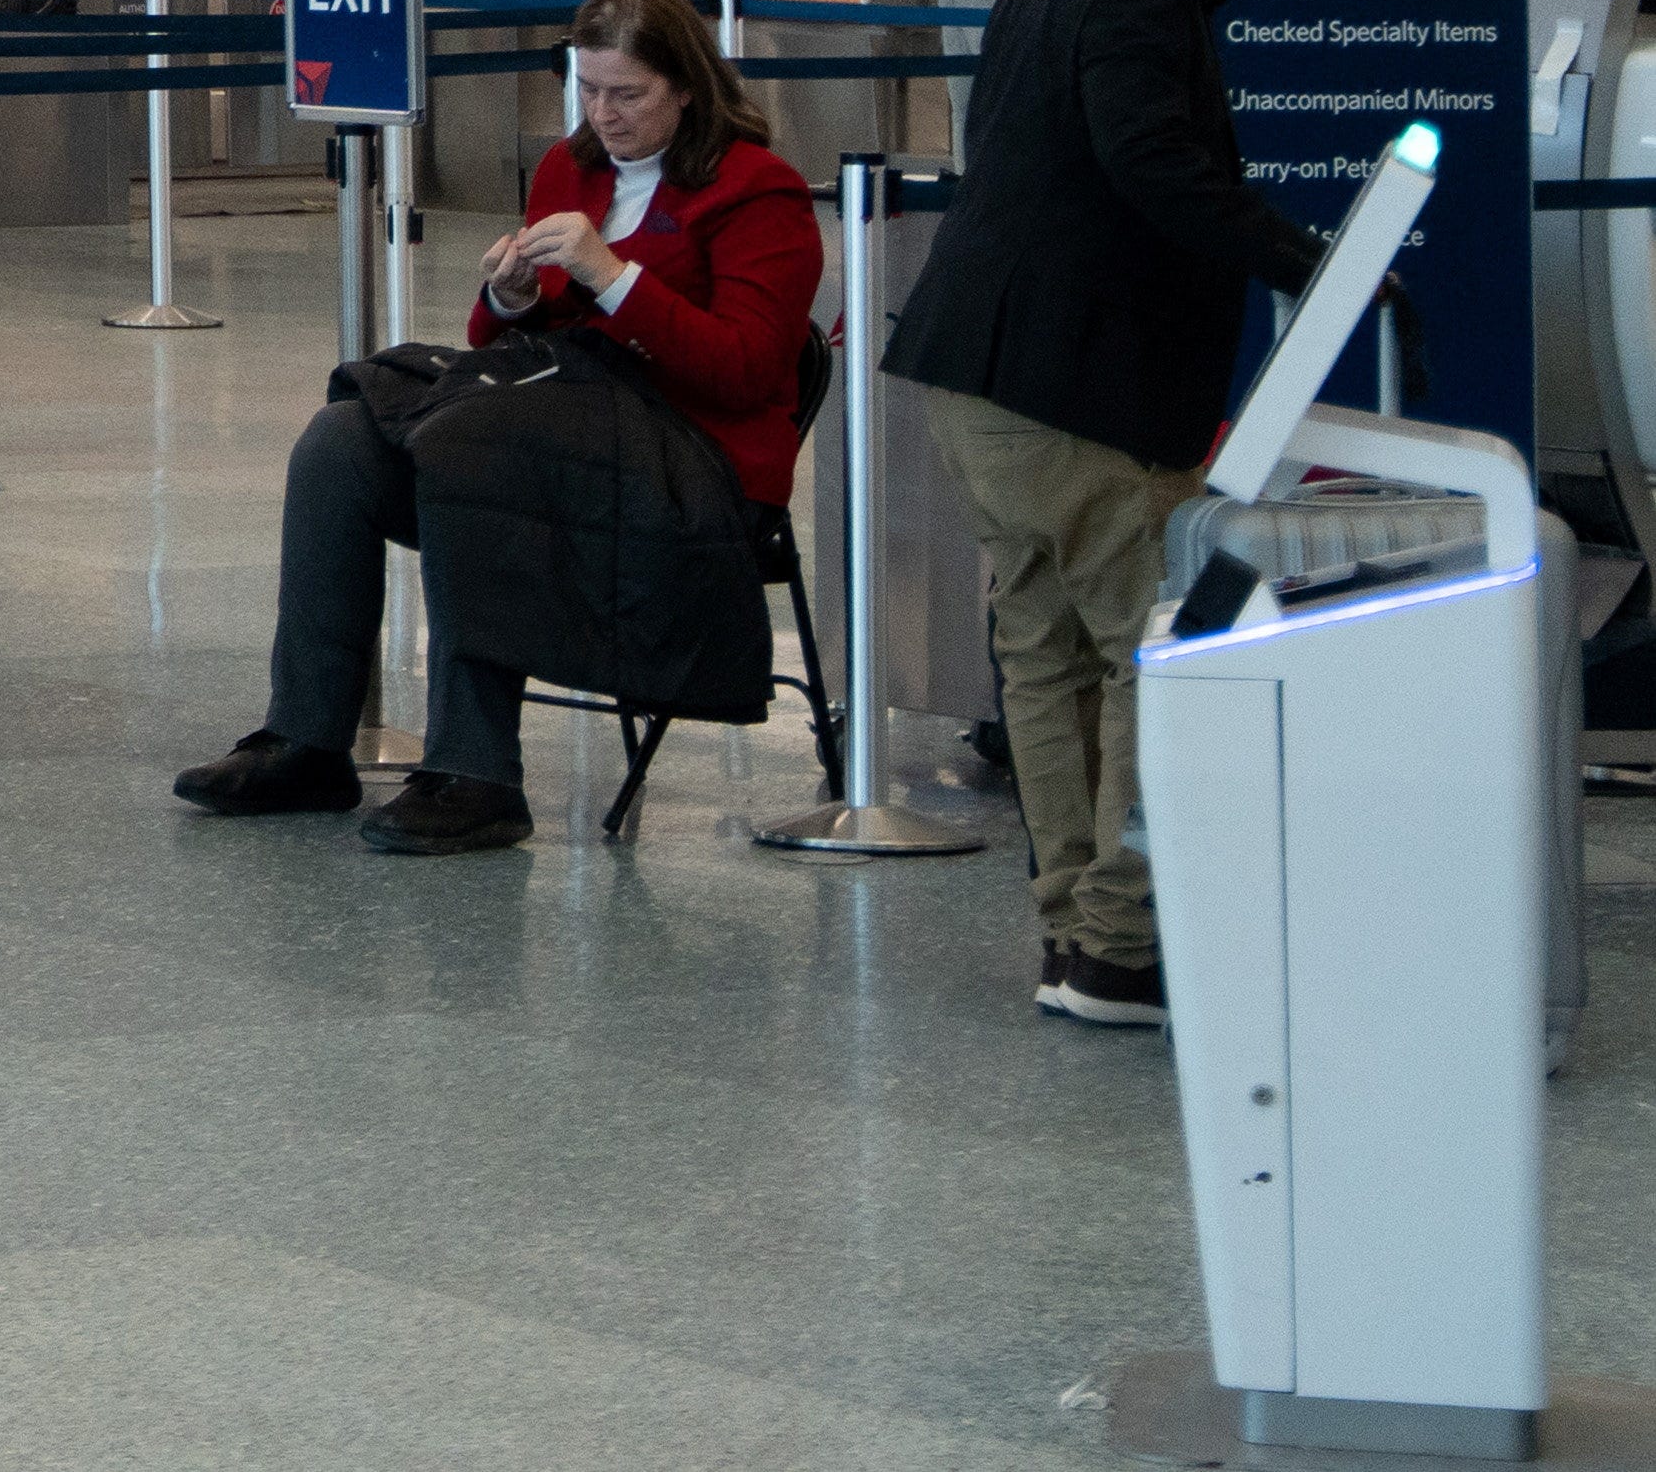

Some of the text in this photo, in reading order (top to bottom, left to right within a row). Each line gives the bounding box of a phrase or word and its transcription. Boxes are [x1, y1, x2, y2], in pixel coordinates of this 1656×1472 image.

[1227, 20, 1498, 47] Checked Specialty Items
[1228, 89, 1494, 115] Unaccompanied Minors
[1241, 157, 1327, 184] arry-on
